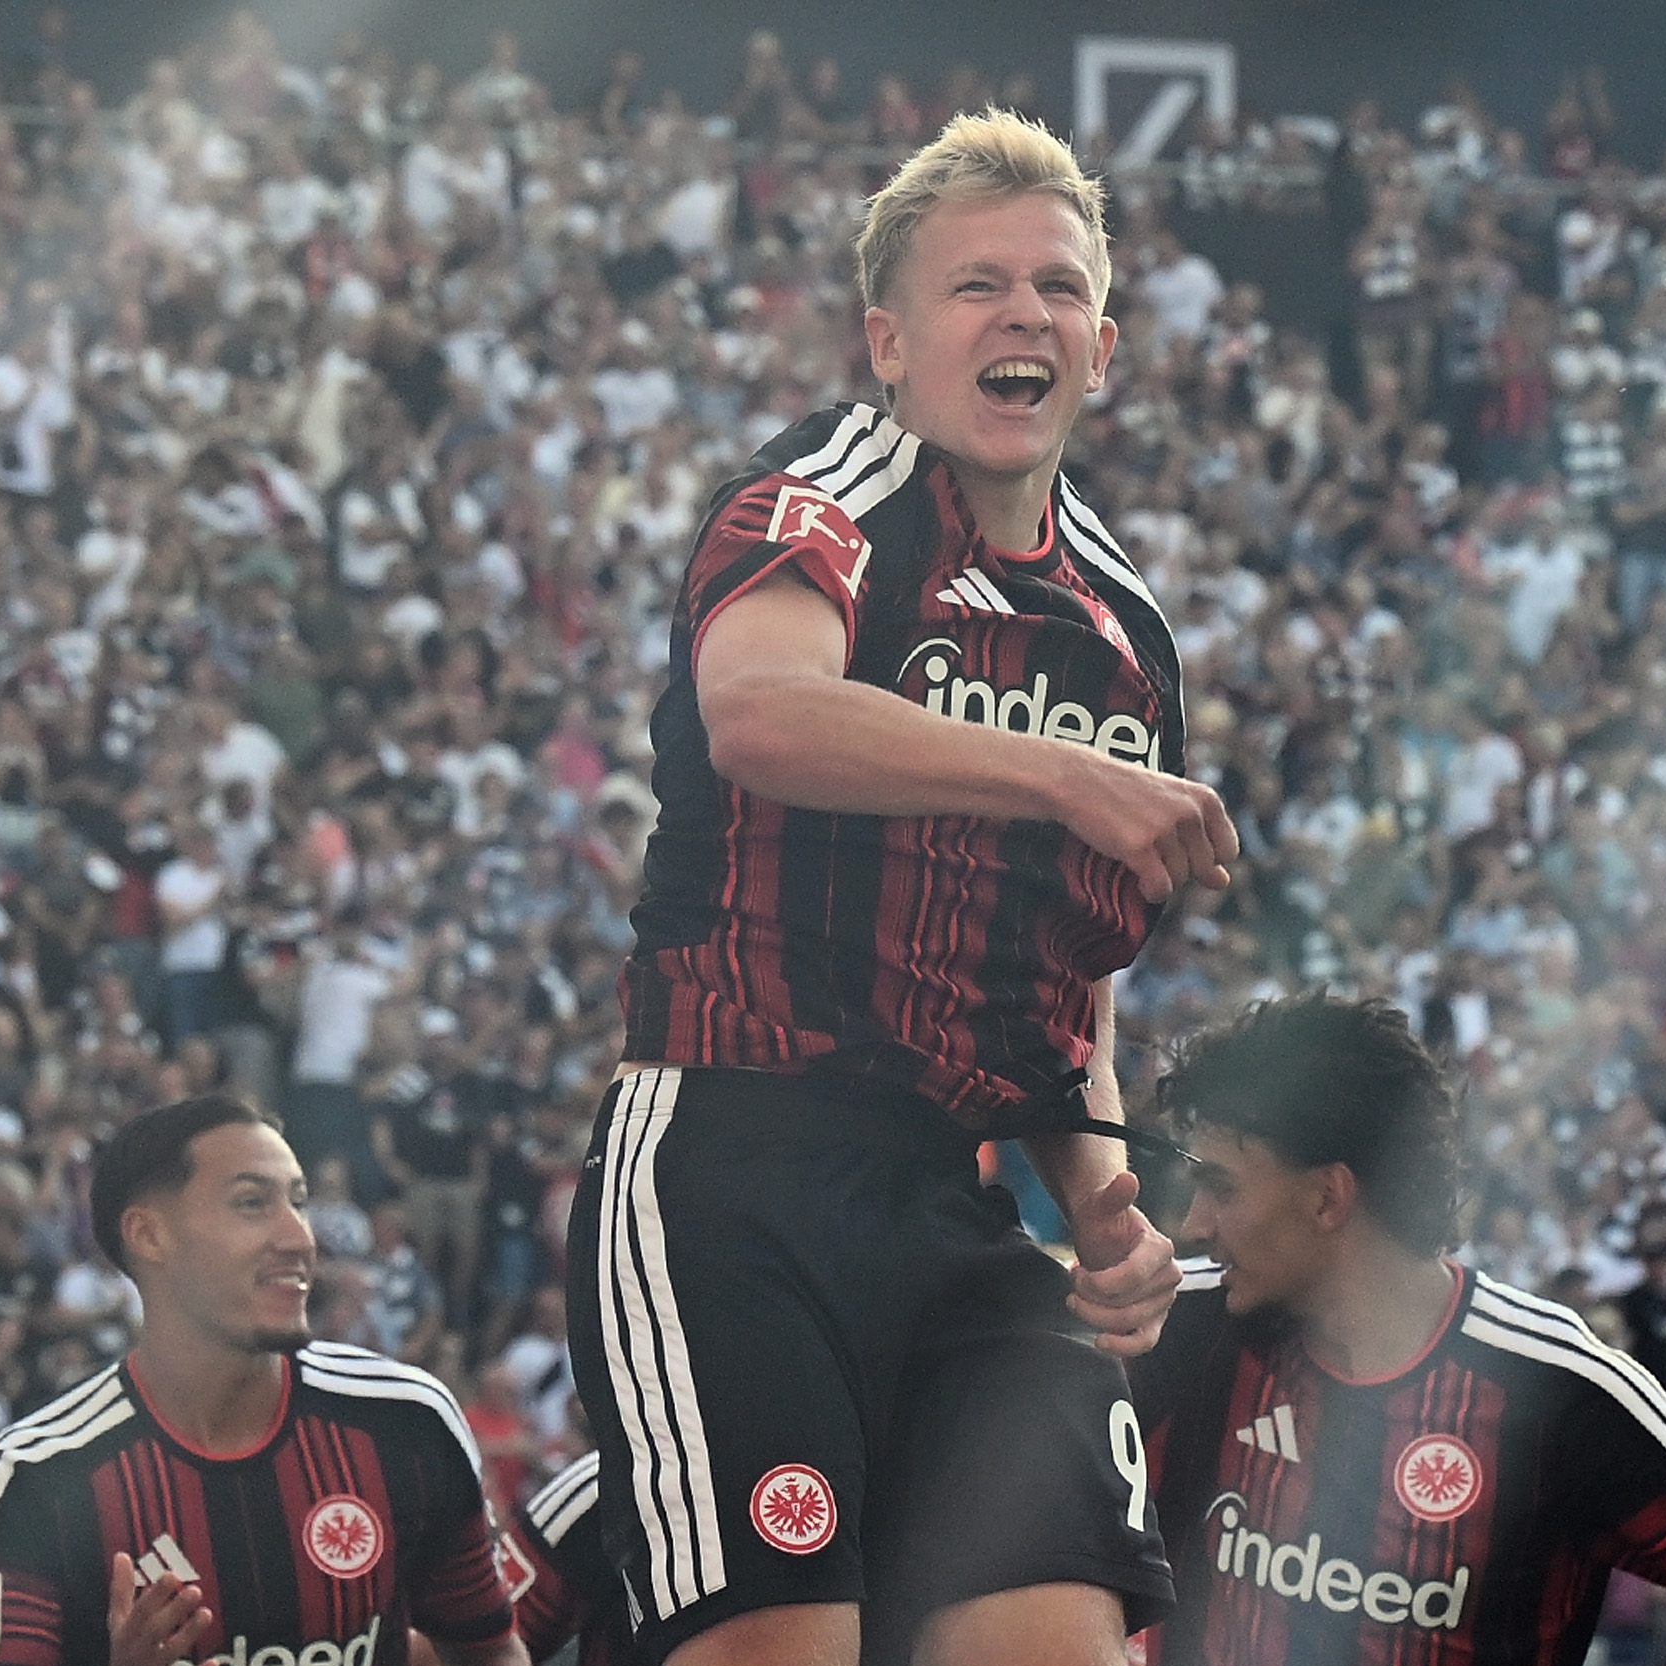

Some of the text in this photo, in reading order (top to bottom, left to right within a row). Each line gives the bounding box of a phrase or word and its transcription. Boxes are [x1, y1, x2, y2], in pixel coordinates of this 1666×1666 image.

[923, 654, 1161, 772] indee
[1108, 1400, 1146, 1533] 9
[1215, 1504, 1470, 1631] indeed
